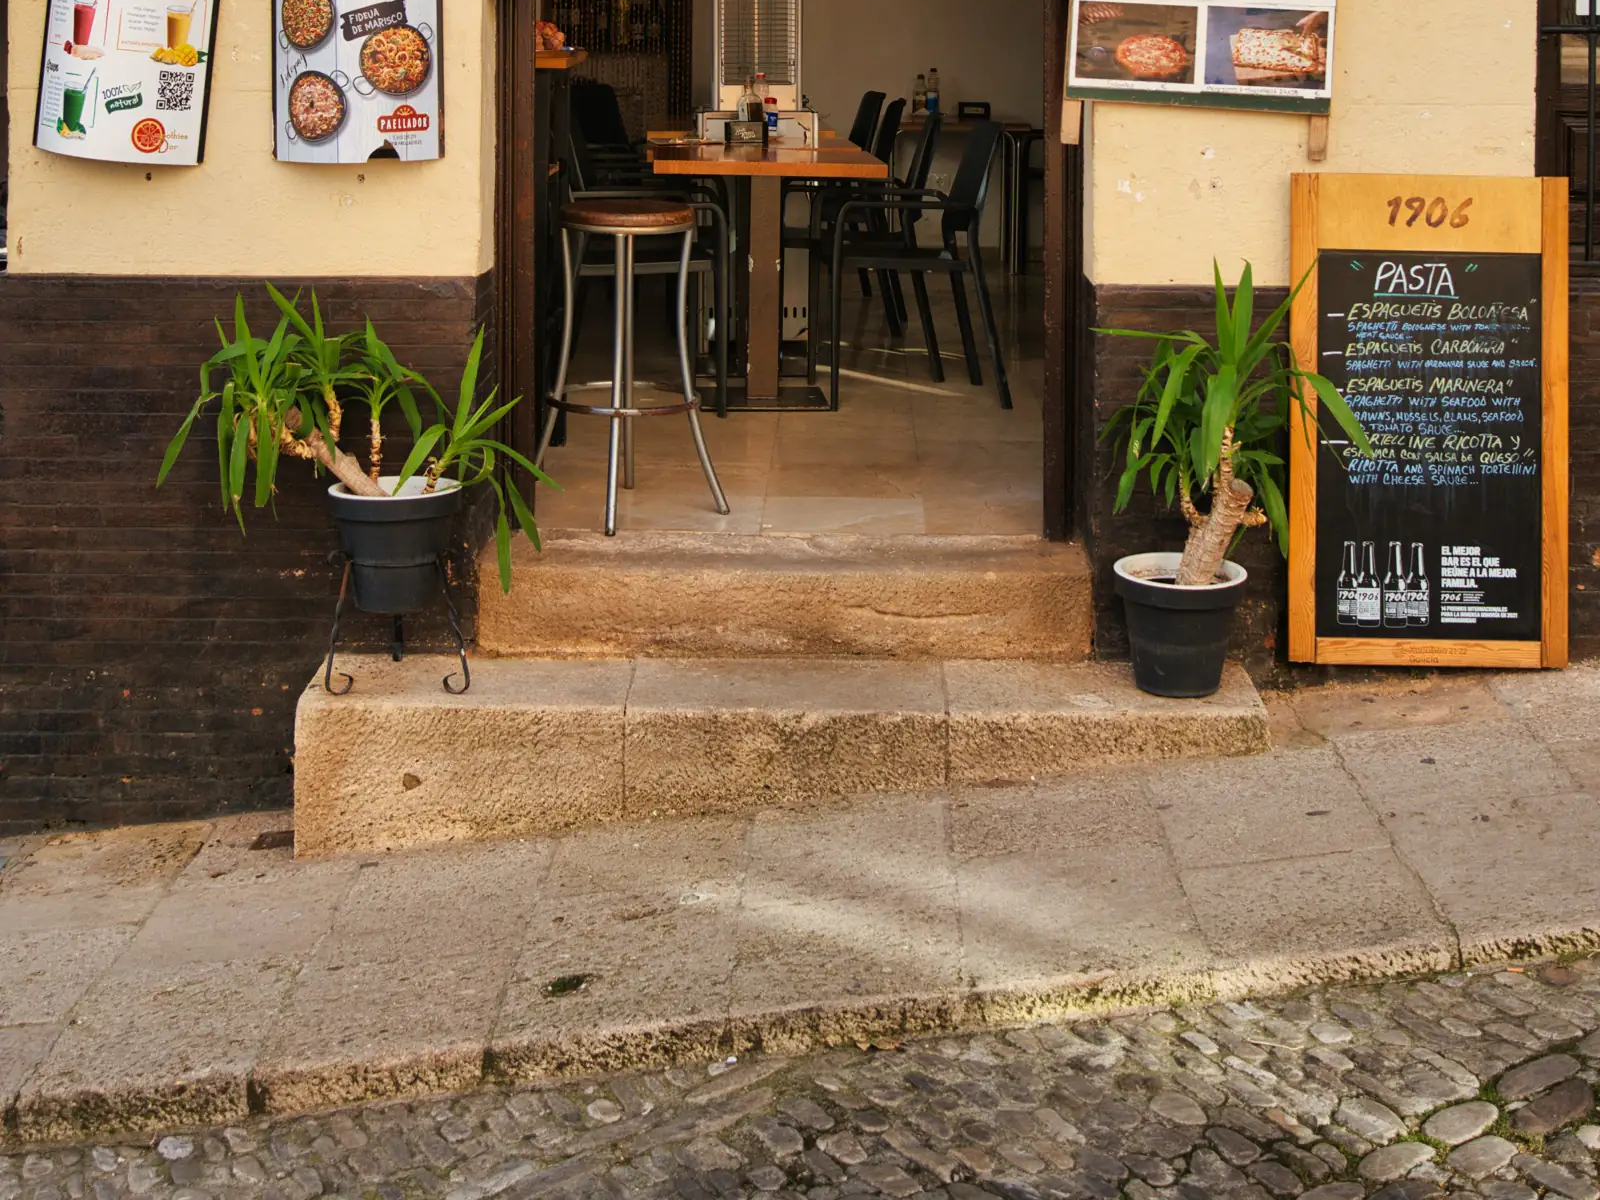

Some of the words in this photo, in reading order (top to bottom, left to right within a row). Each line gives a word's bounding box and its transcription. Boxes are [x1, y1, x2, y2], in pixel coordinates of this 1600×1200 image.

[351, 24, 363, 35] DE
[364, 11, 403, 32] MARISCO
[102, 85, 123, 100] 100%
[109, 95, 139, 110] natural
[379, 116, 428, 130] PAELLADOR
[1386, 195, 1474, 229] 1906
[1374, 261, 1456, 297] PASTA
[1346, 300, 1442, 321] ESPAGUETIS
[1347, 321, 1399, 332] SPAGHETTI
[1450, 323, 1472, 332] WITH
[1345, 340, 1424, 357] ESPAGUETIS
[1345, 358, 1393, 370] SPAGHETTI
[1396, 358, 1424, 369] WITH
[1467, 360, 1489, 369] SAUCE
[1491, 360, 1506, 368] AND
[1346, 376, 1424, 393] ESPAGUETIS
[1344, 395, 1404, 408] SPAGHETTI
[1408, 396, 1435, 407] WITH
[1441, 395, 1487, 408] SEAFOOD
[1491, 396, 1521, 407] WITH
[1481, 409, 1524, 423] SEAFOOD
[1368, 423, 1413, 433] TOMATO
[1442, 433, 1503, 451] RICOTTA
[1399, 448, 1422, 461] CON
[1424, 451, 1458, 463] SALSA
[1347, 458, 1399, 473] RICOTTA
[1403, 464, 1424, 474] AND
[1428, 463, 1476, 475] SPINACH
[1349, 474, 1378, 485] WITH
[1382, 474, 1427, 485] CHEESE
[1441, 545, 1452, 556] EL
[1452, 546, 1481, 556] MEJOR
[1441, 557, 1460, 567] BAR
[1460, 557, 1471, 567] ES
[1471, 557, 1482, 567] EL
[1482, 557, 1500, 568] QUE
[1441, 565, 1469, 577] REÚNE
[1469, 568, 1476, 577] A
[1476, 568, 1488, 578] LA
[1488, 568, 1517, 578] MEJOR
[1441, 578, 1478, 588] FAMILIA.
[1440, 593, 1462, 602] 1906
